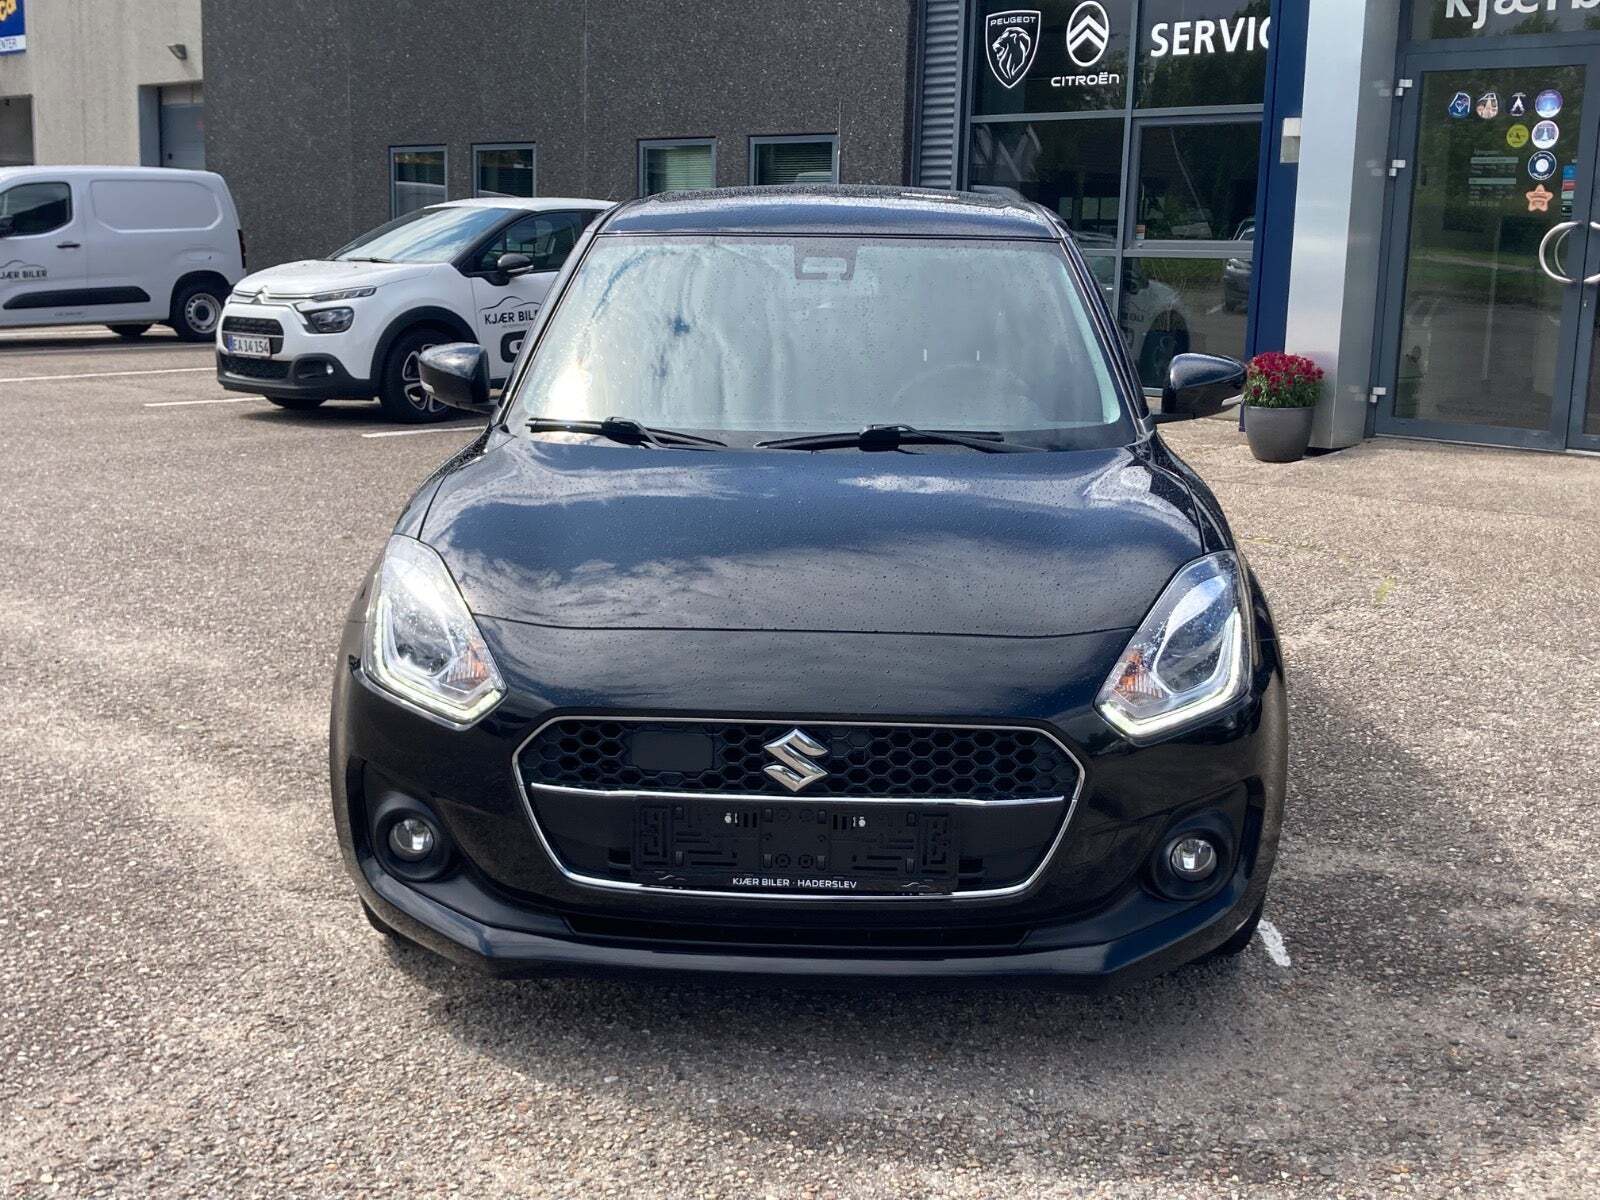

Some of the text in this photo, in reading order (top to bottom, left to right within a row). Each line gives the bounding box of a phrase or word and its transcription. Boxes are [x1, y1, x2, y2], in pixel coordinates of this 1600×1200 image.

[990, 16, 1037, 26] PEUGEOT
[484, 312, 515, 325] KJÆR
[732, 877, 857, 889] KJÆR BILER HADERSLEV
